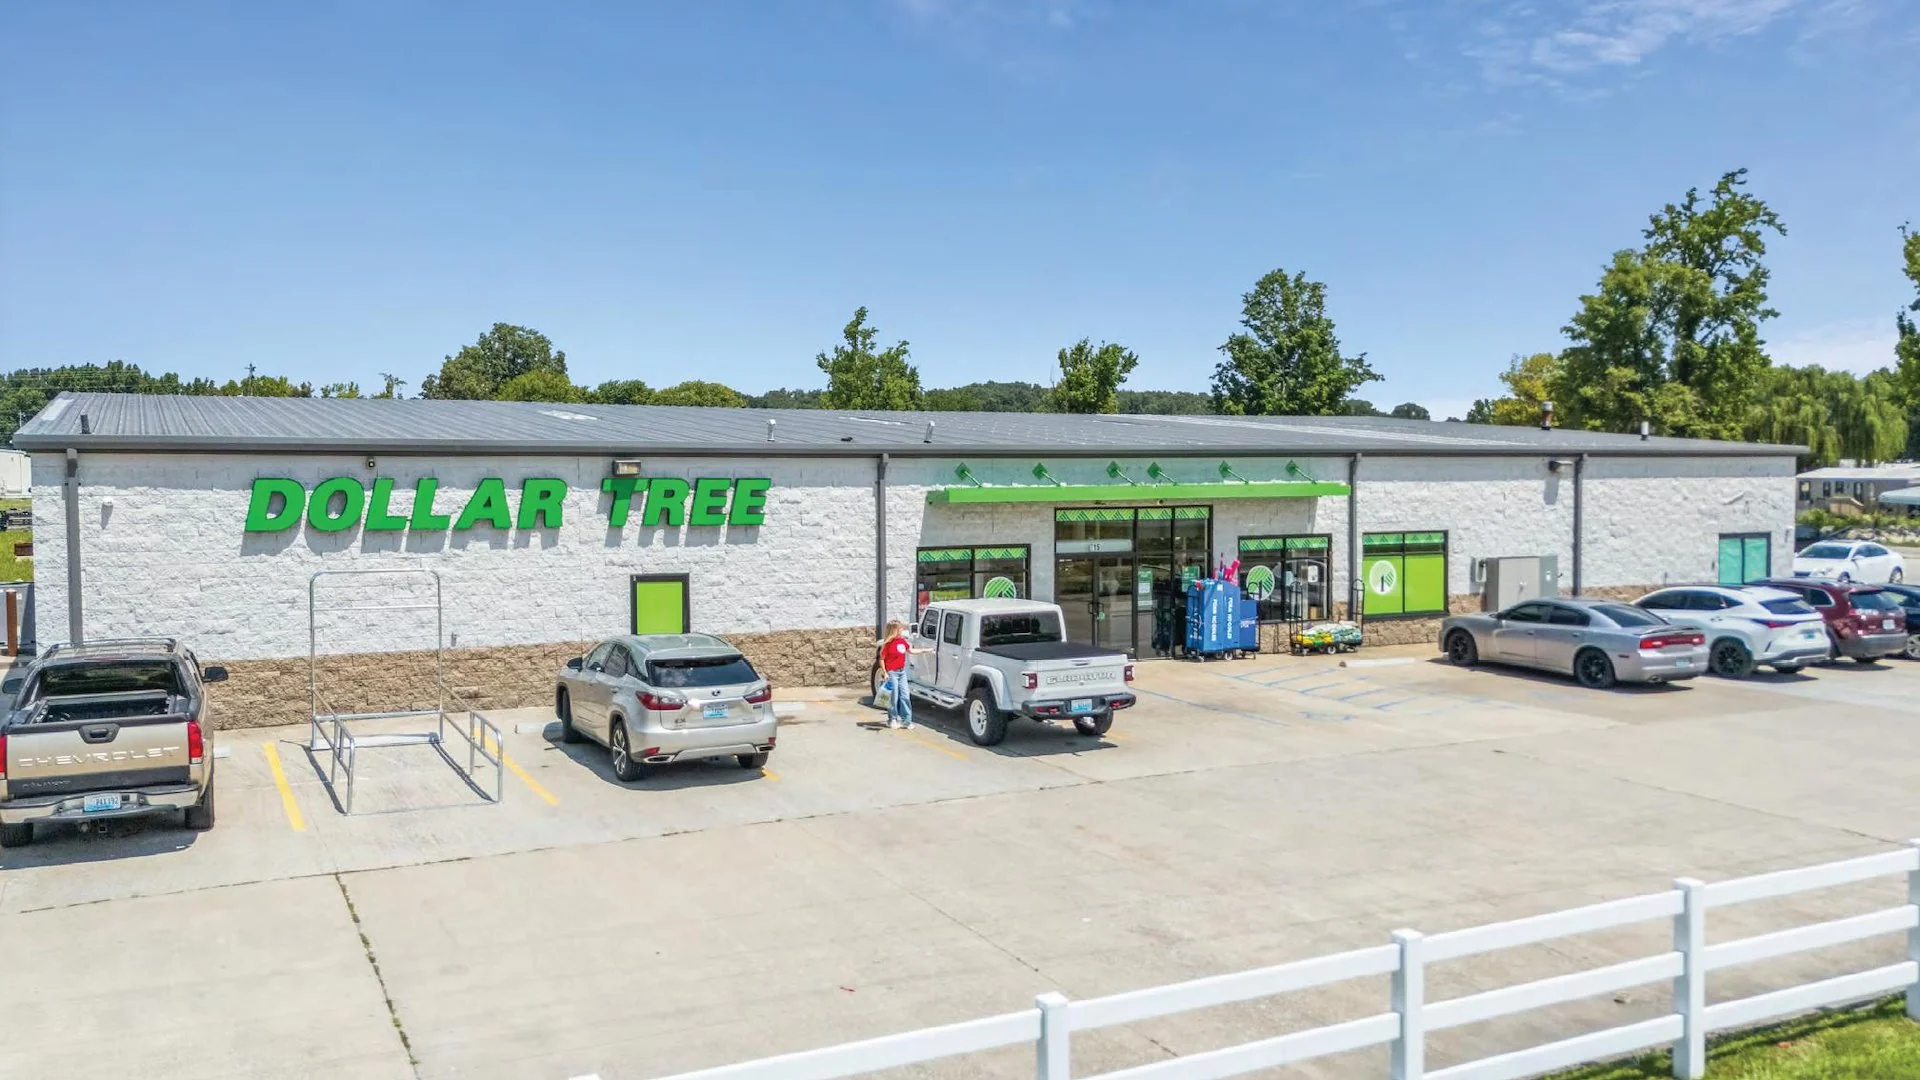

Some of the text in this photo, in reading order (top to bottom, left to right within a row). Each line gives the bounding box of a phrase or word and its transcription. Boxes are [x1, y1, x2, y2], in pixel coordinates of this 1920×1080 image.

[245, 477, 772, 532] DOLLAR TREE
[18, 746, 181, 767] CHEVROLET
